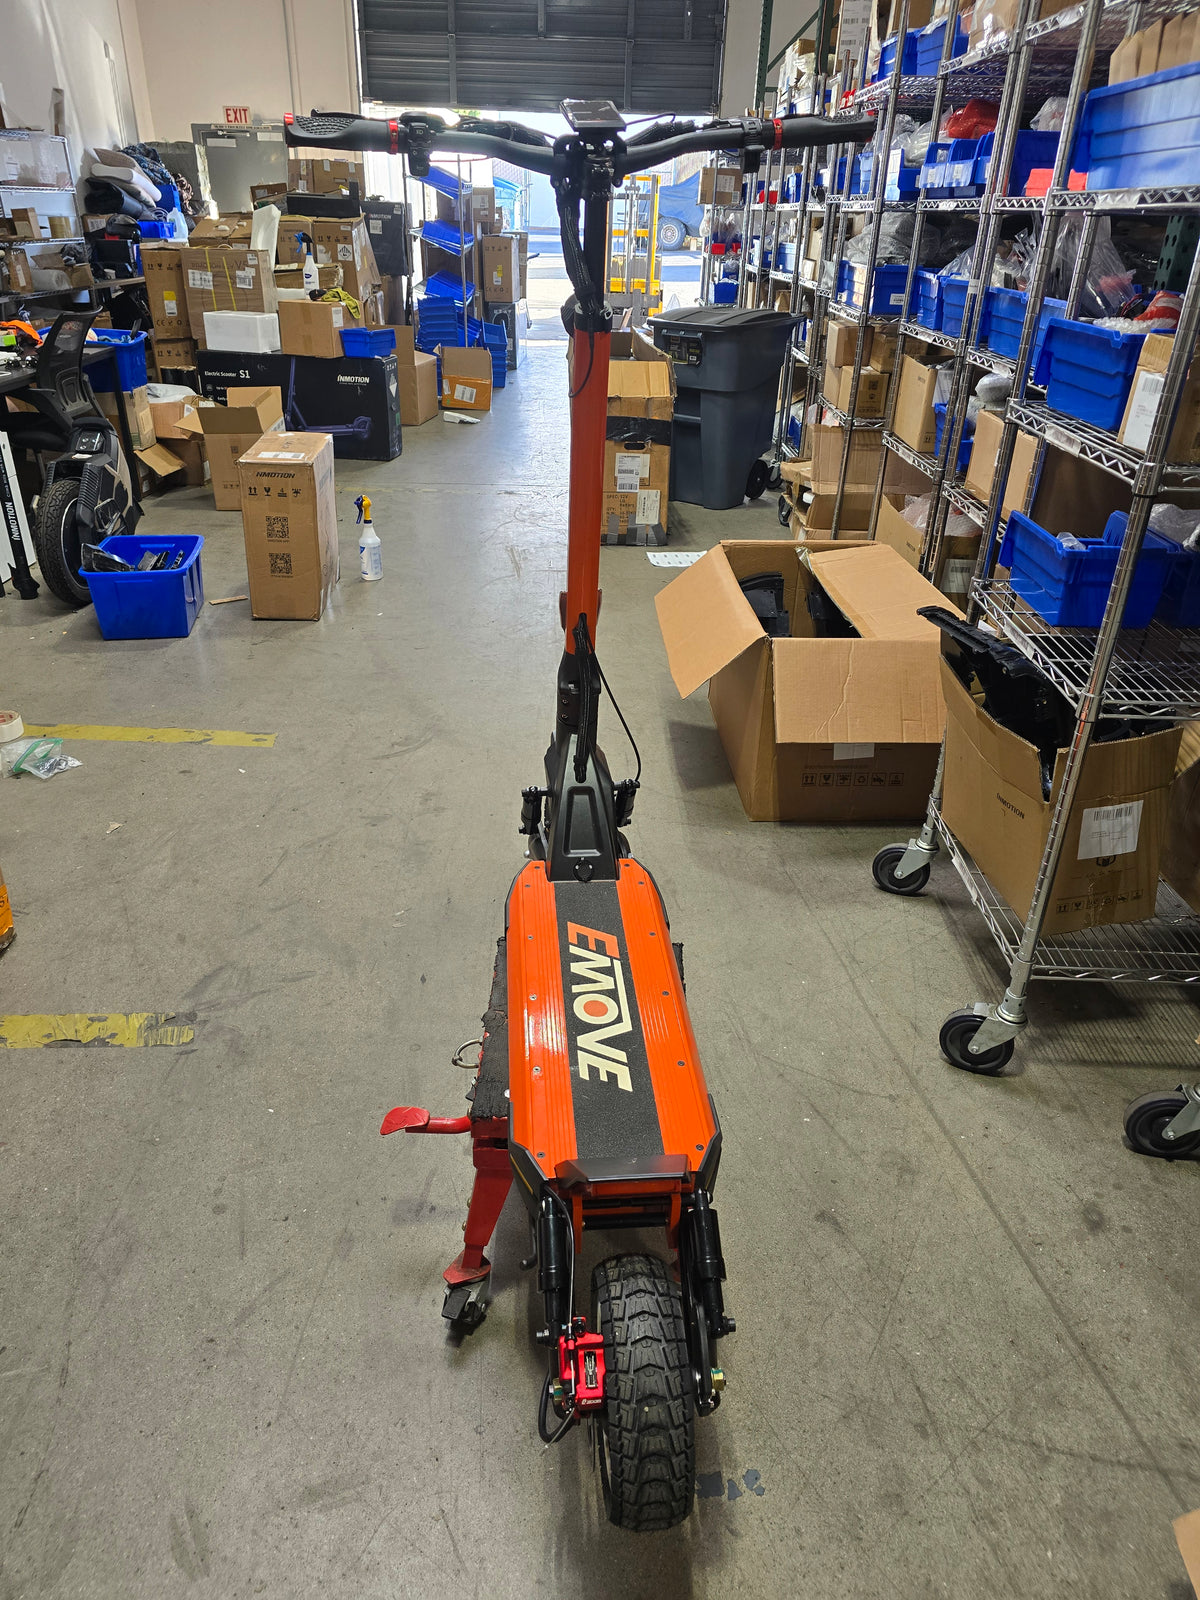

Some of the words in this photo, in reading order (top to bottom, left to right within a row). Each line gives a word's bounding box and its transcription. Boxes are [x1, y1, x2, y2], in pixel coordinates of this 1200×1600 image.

[225, 108, 248, 123] EXIT
[239, 369, 251, 379] S1
[337, 374, 370, 383] INMOTION
[4, 501, 20, 541] INMOTION
[996, 792, 1025, 819] INMOTION
[567, 921, 633, 1092] EMOVE
